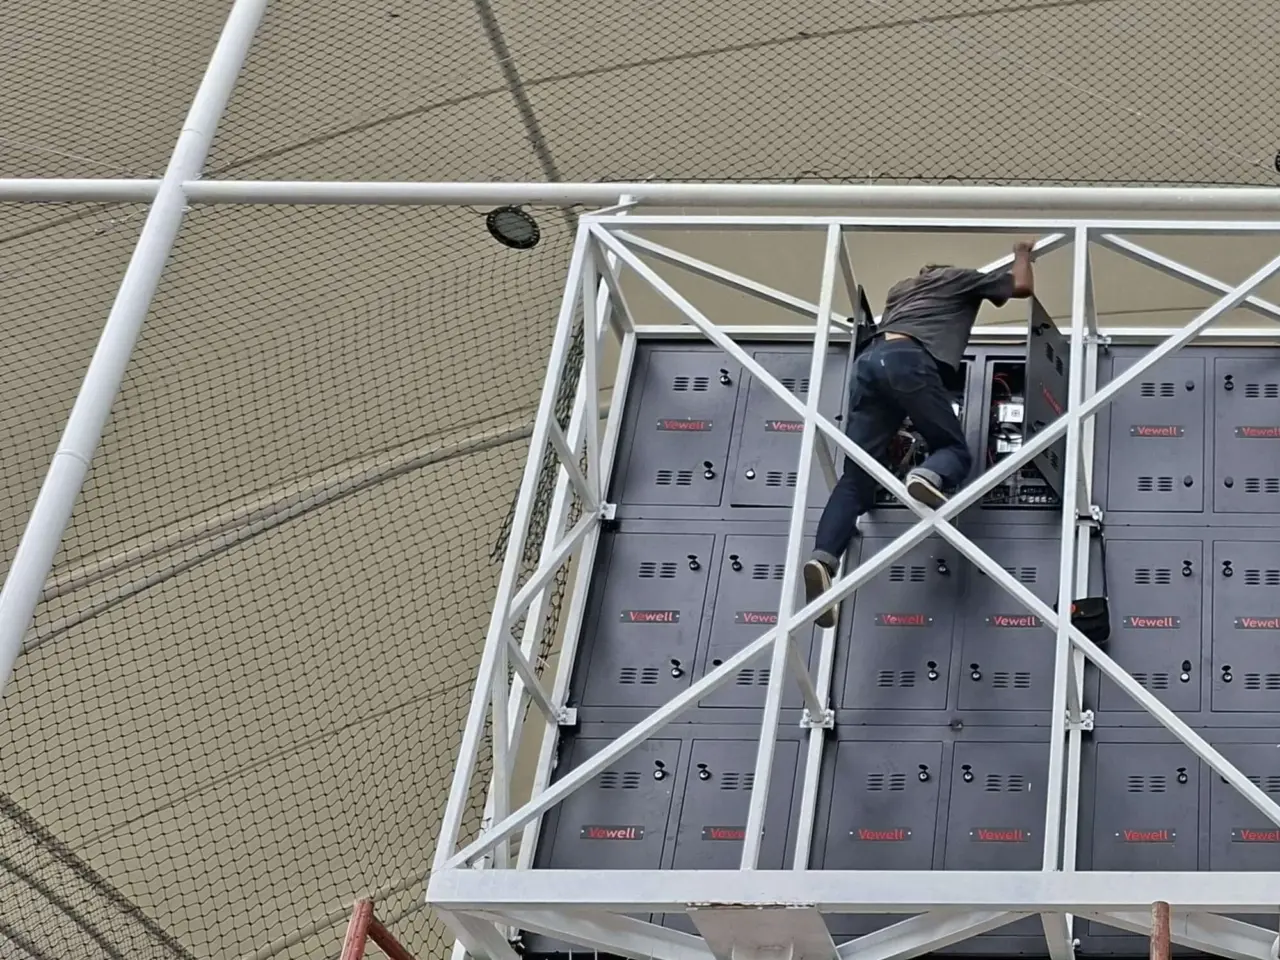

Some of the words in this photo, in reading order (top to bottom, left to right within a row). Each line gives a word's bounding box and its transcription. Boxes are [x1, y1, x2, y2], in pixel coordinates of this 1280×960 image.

[663, 421, 705, 430] Vewell
[772, 421, 804, 431] Vewe
[1136, 426, 1178, 436] Vewell
[629, 611, 673, 622] Vewell
[743, 612, 777, 624] Vewe
[881, 615, 924, 625] Vewell
[993, 616, 1036, 627] Vewell
[1130, 617, 1173, 628] Vewell
[588, 826, 636, 839] Vewell
[710, 827, 745, 839] Vewe
[858, 829, 904, 841] Vewell
[978, 829, 1024, 841] Vewell
[1123, 830, 1168, 841] Vewell
